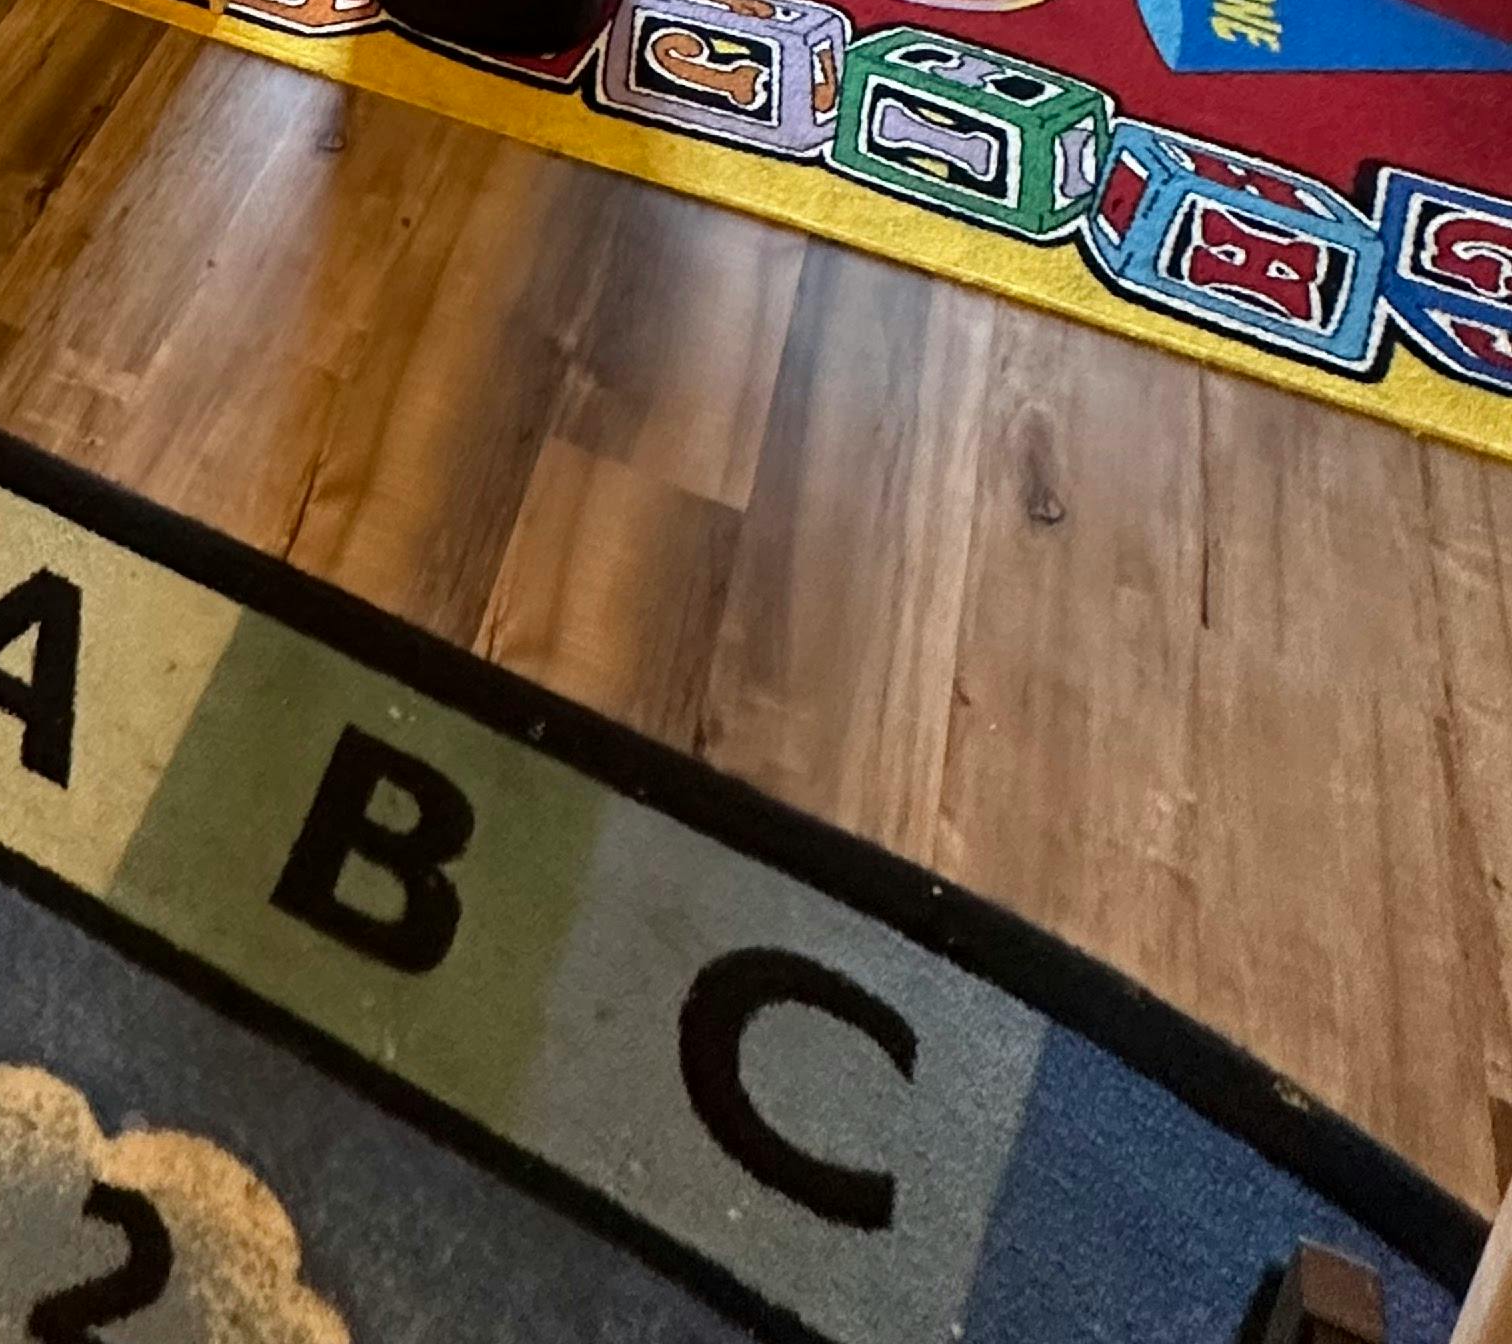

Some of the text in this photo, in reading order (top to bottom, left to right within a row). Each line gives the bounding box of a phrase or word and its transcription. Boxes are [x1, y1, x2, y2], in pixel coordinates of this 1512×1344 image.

[269, 728, 476, 974] B
[680, 947, 919, 1230] C
[28, 1181, 173, 1344] 2
